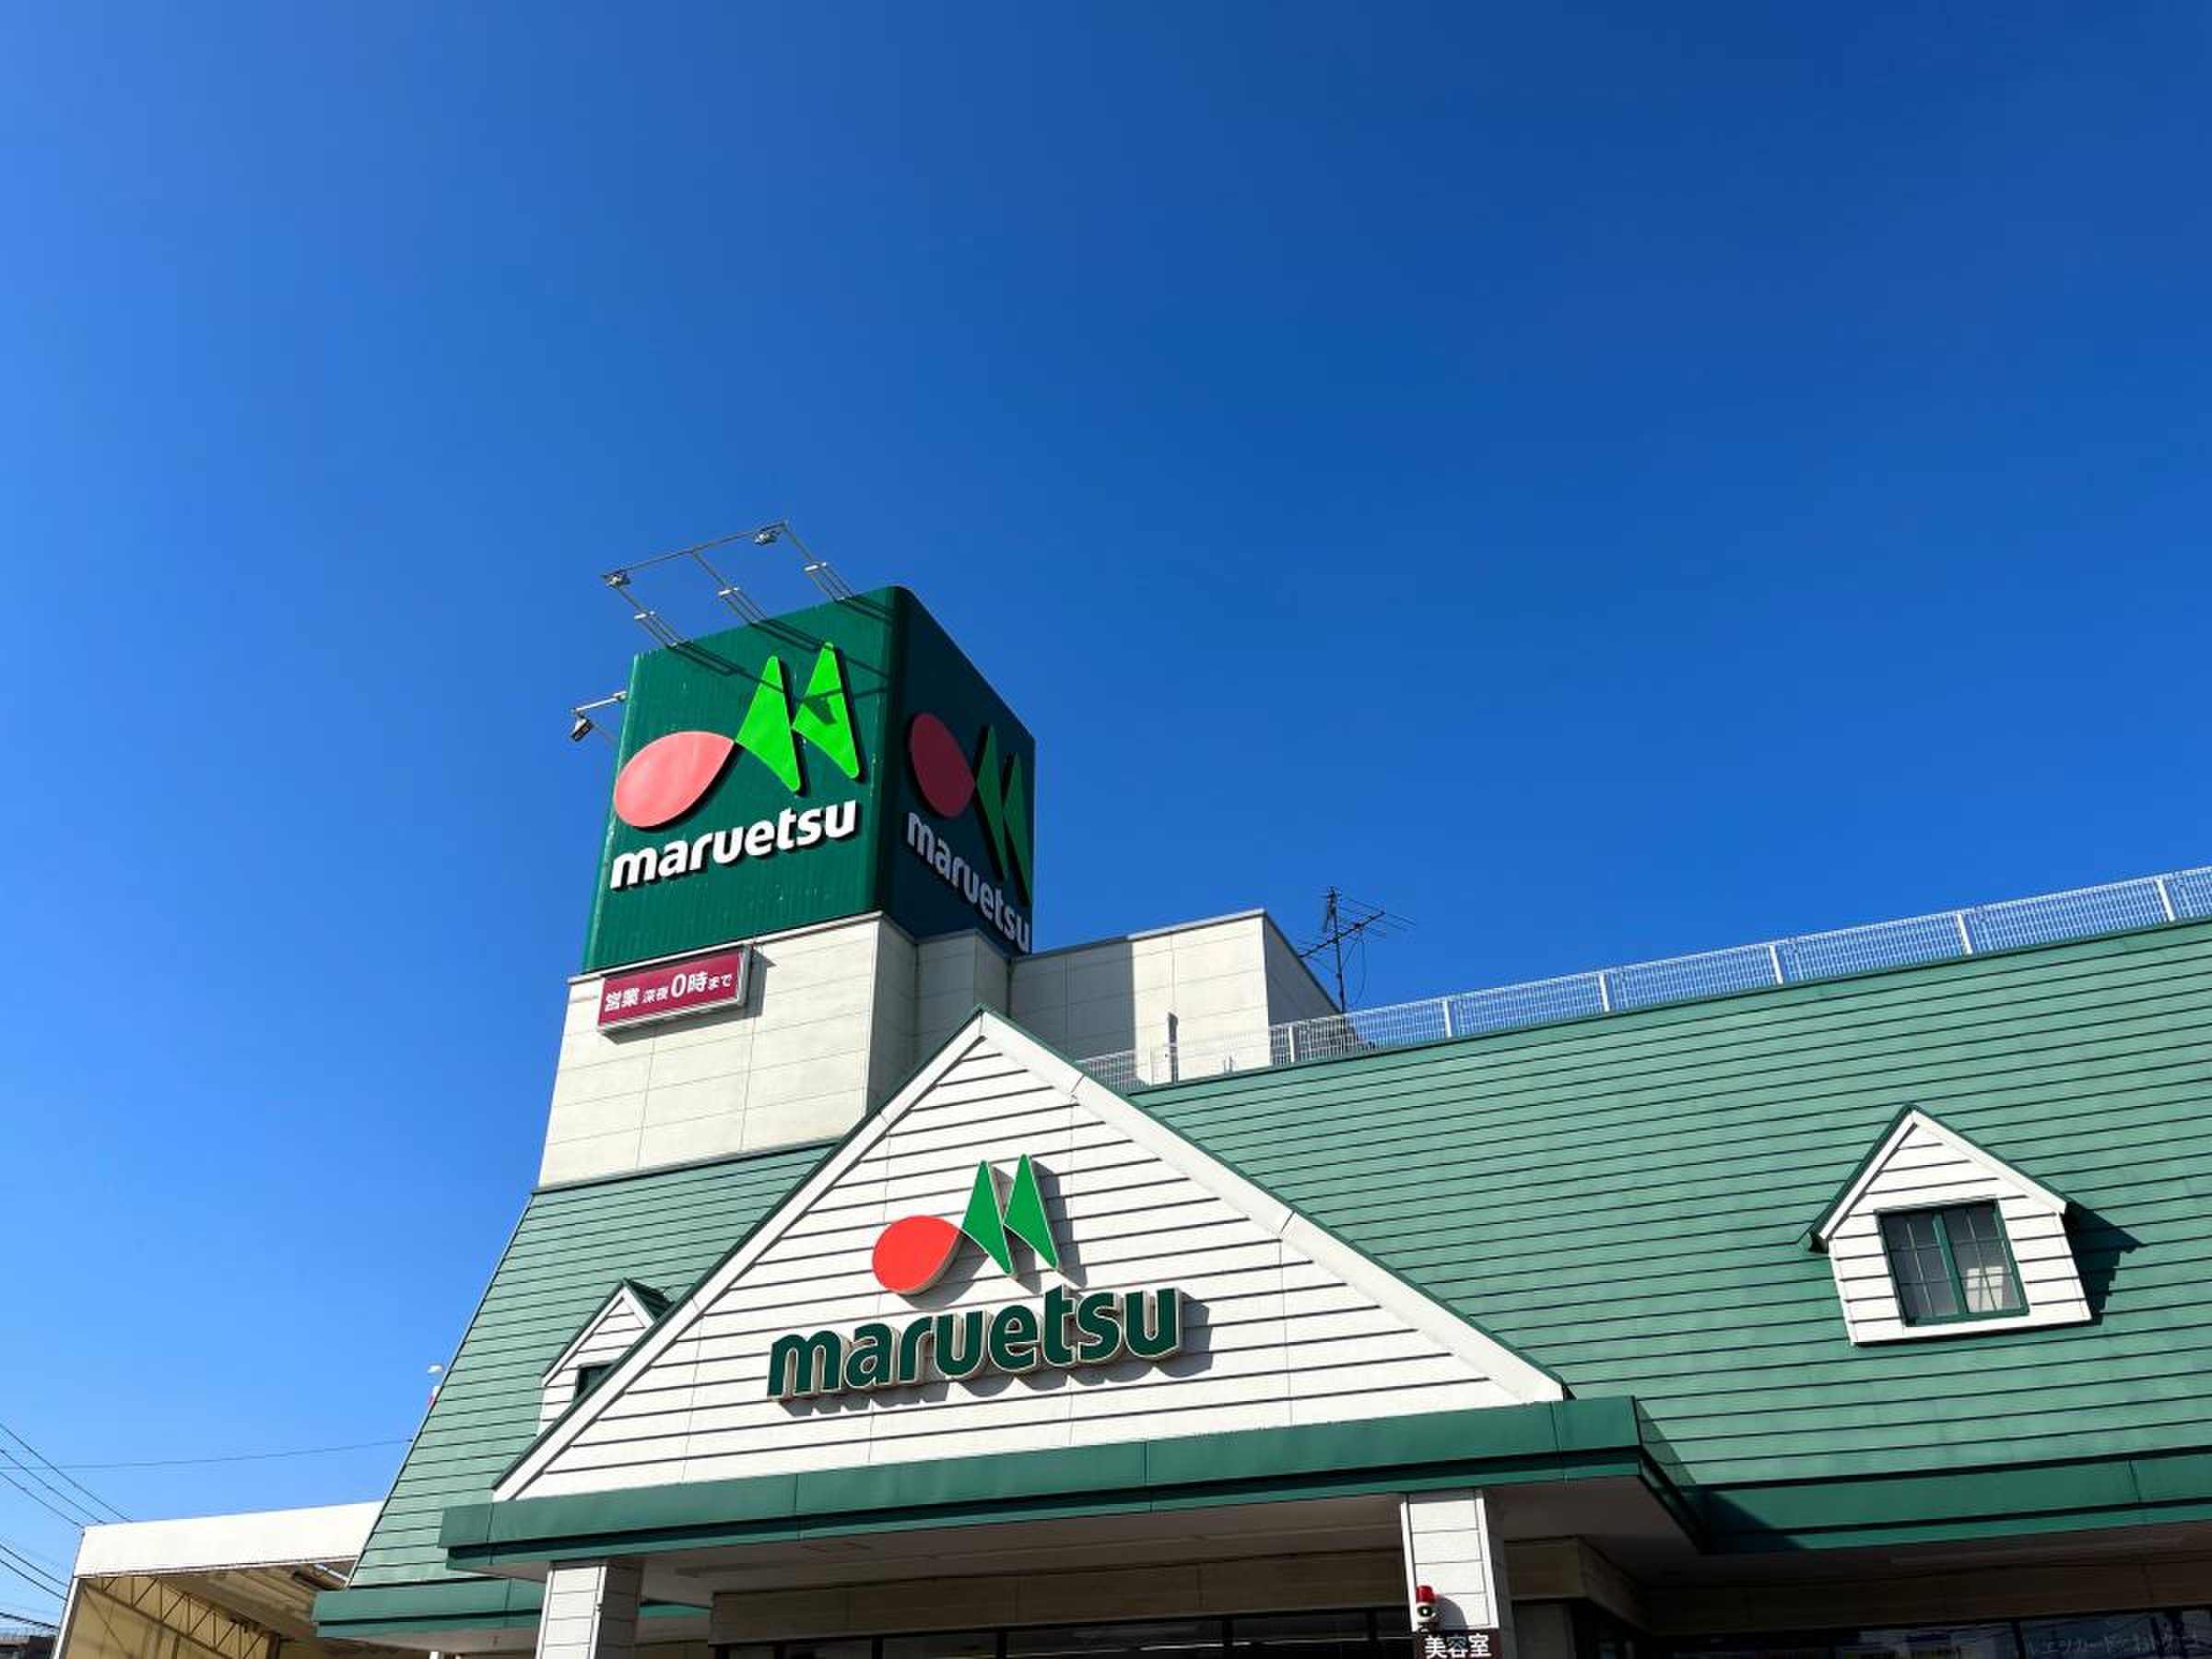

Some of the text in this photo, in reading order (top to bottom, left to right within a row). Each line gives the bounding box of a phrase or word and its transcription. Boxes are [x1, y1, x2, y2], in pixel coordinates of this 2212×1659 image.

[610, 800, 855, 888] maruetsu
[907, 811, 1030, 953] maruetsu
[767, 1283, 1183, 1401] maruetsu
[1424, 1633, 1492, 1659] 美容室
